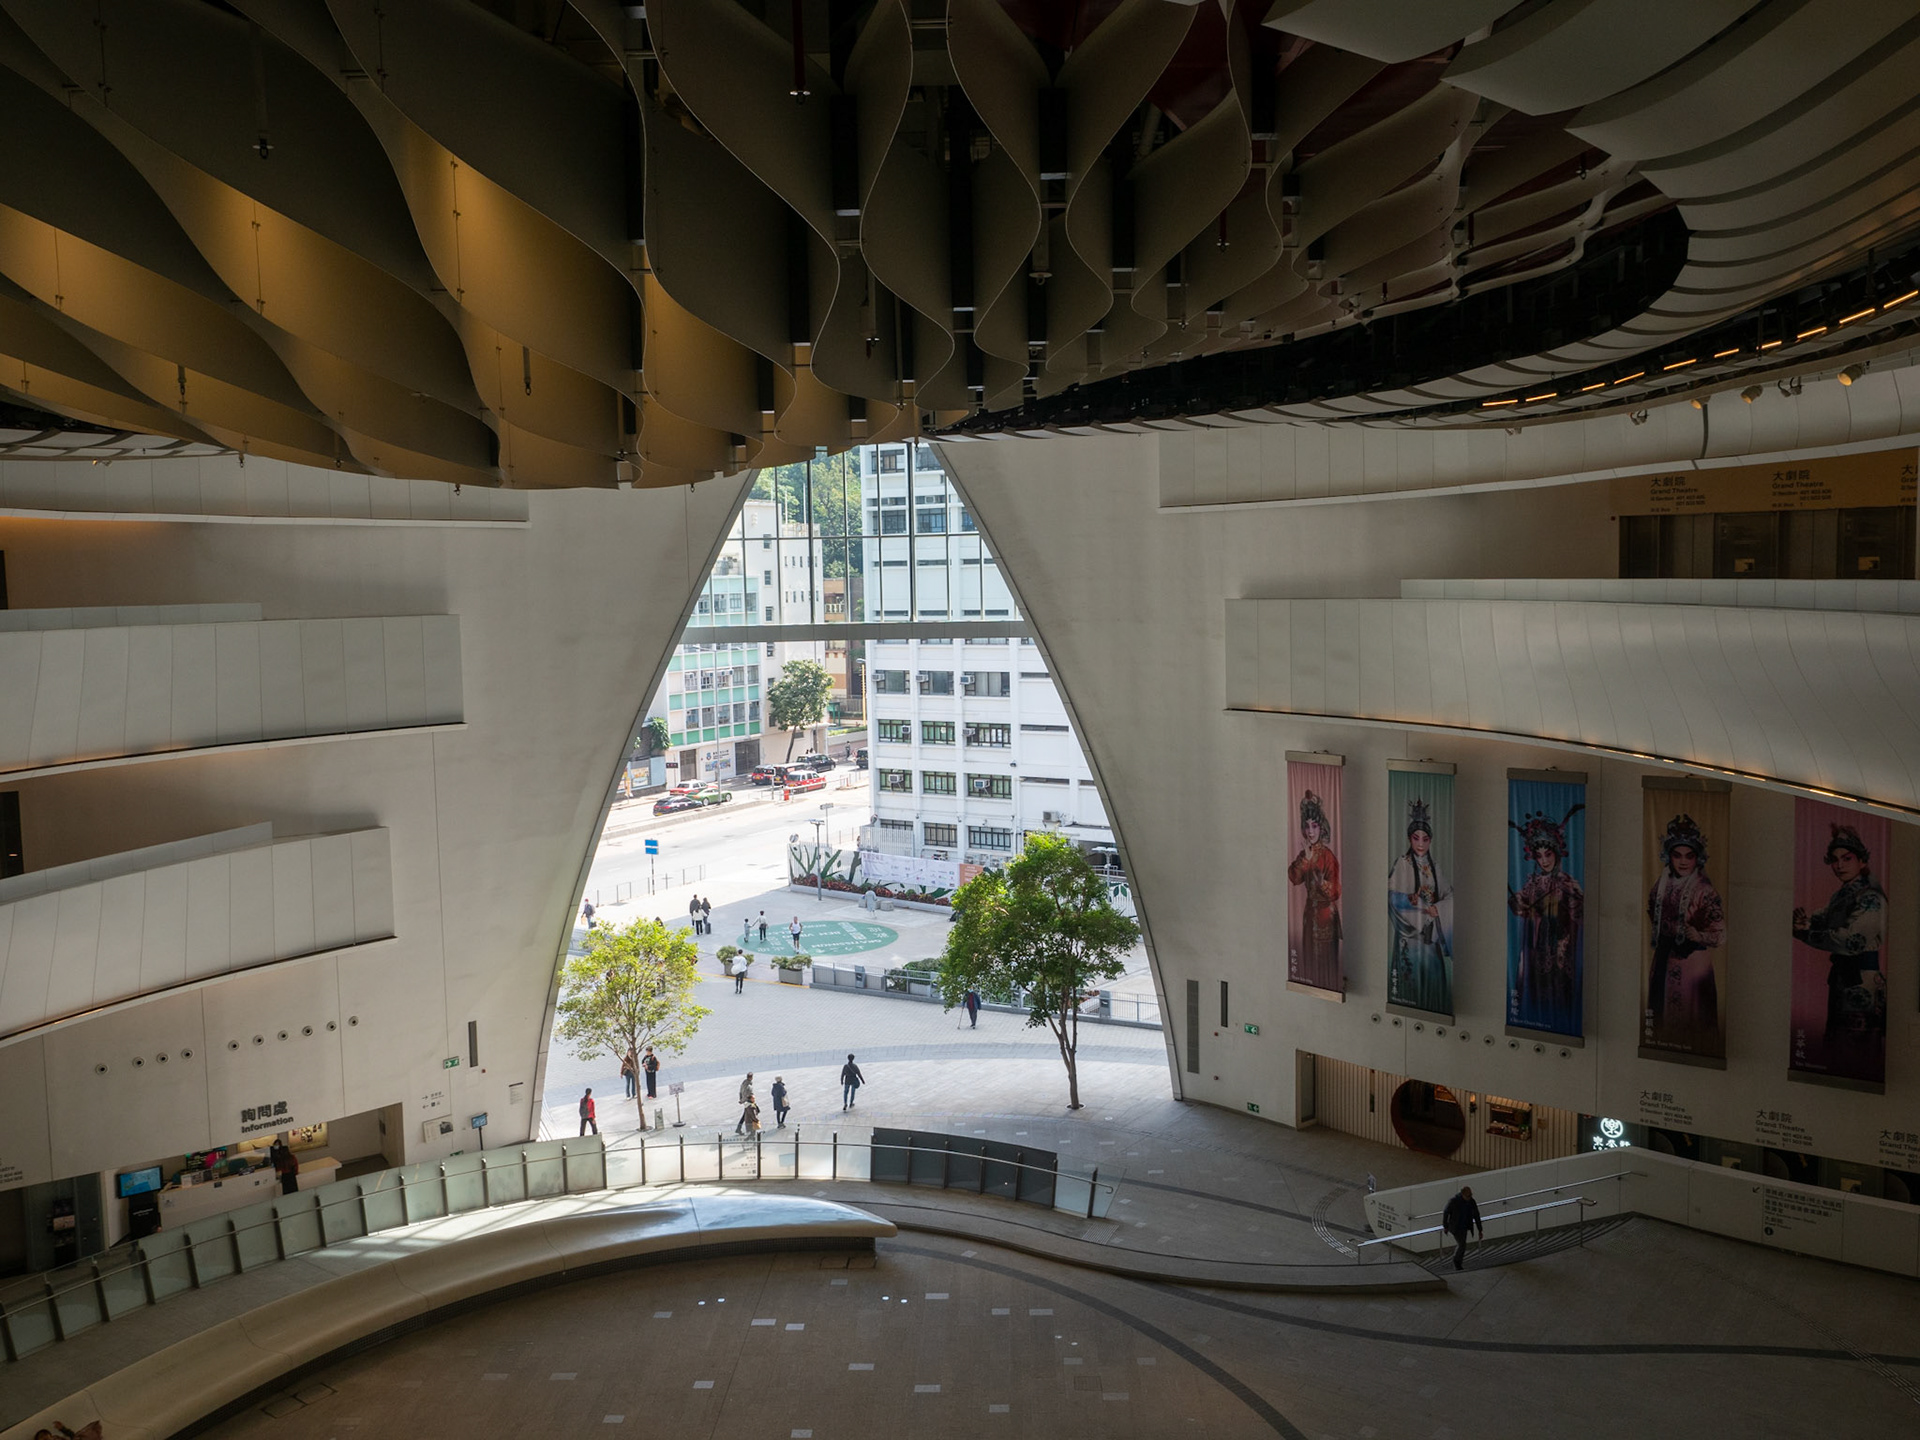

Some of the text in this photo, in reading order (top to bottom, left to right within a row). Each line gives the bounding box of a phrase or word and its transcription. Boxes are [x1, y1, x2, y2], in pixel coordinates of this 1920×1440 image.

[1640, 1090, 1673, 1103] 大劇院
[241, 1101, 288, 1123] 詢問處
[1639, 1100, 1685, 1112] Grand Theatre
[1756, 1109, 1792, 1123] 大劇院
[241, 1116, 294, 1133] Information
[1756, 1120, 1805, 1132] Grand Theatre
[1880, 1129, 1919, 1144] 大劇院
[1879, 1140, 1902, 1149] Grand
